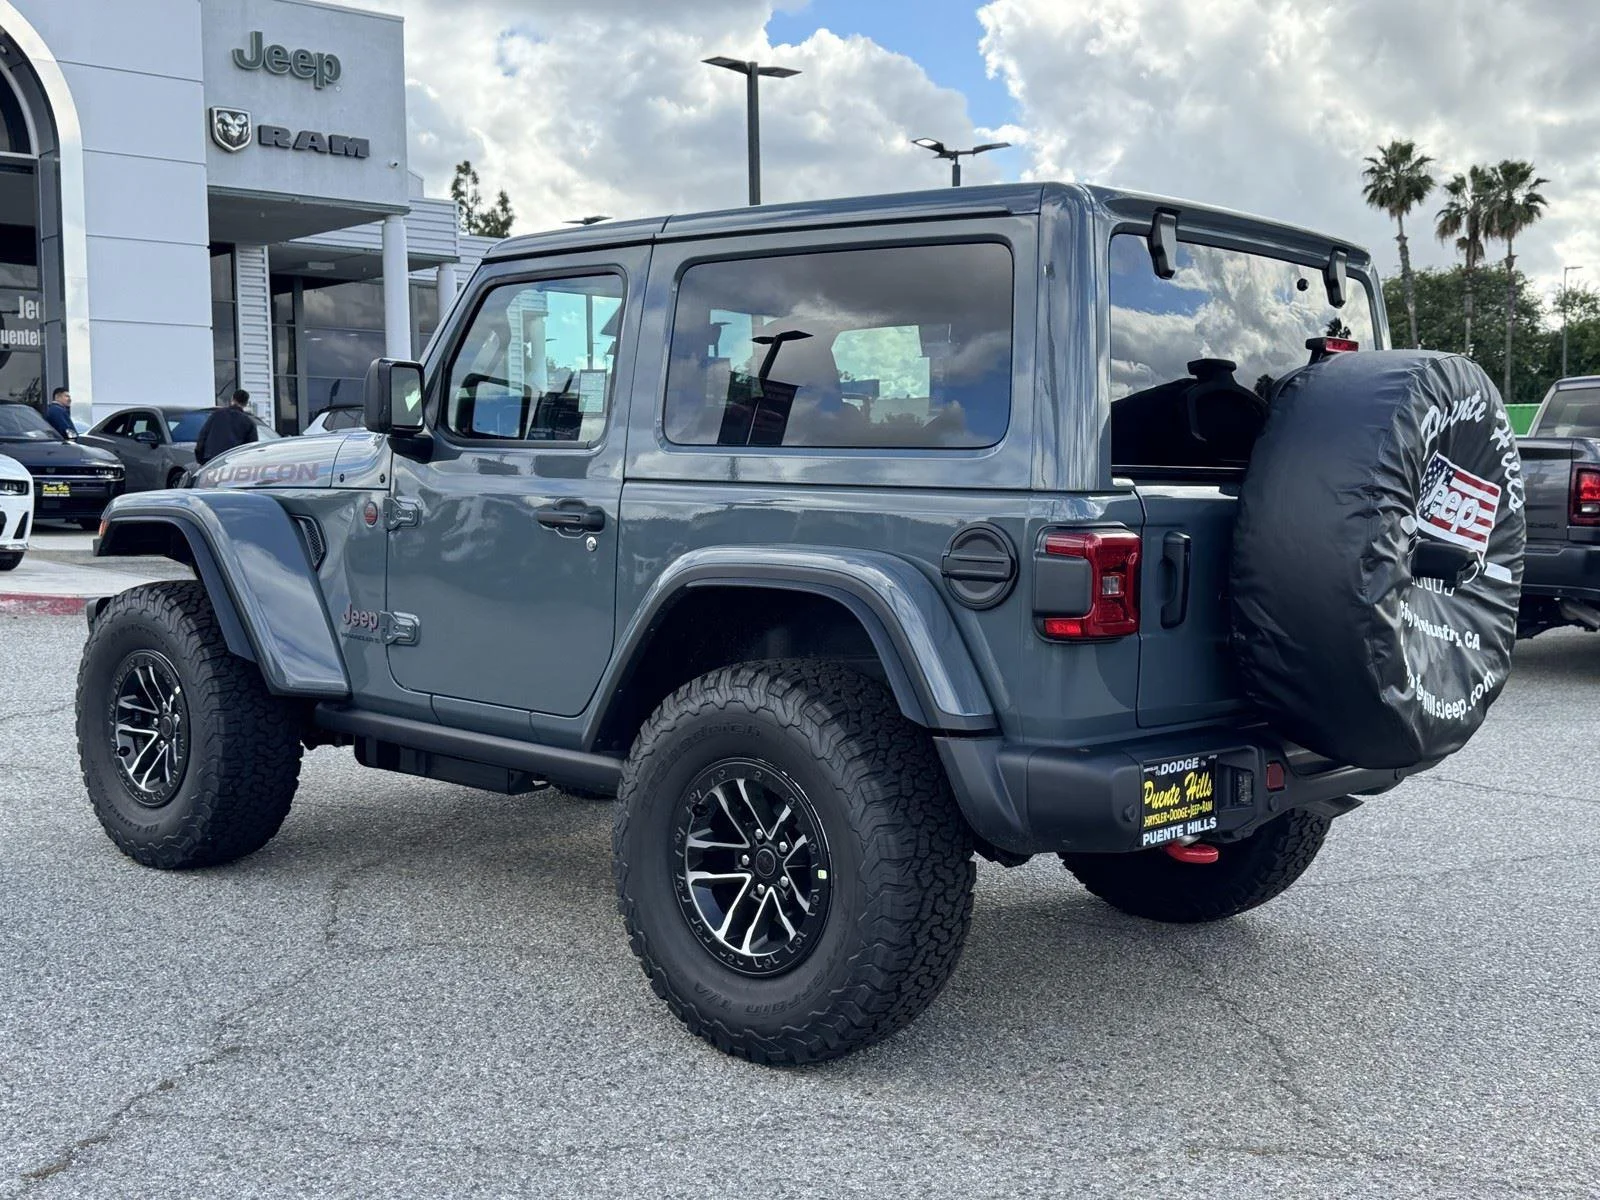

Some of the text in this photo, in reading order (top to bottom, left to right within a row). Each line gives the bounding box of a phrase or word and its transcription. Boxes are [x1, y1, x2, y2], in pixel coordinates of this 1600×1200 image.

[231, 31, 342, 90] Jeep
[258, 124, 370, 159] RAM
[199, 463, 320, 488] RUBICON
[342, 604, 379, 633] Jeep
[1464, 630, 1481, 650] CA
[1160, 757, 1199, 776] DODGE
[1143, 771, 1213, 809] Puente Hills
[1142, 817, 1217, 846] PUENTE HILLS
